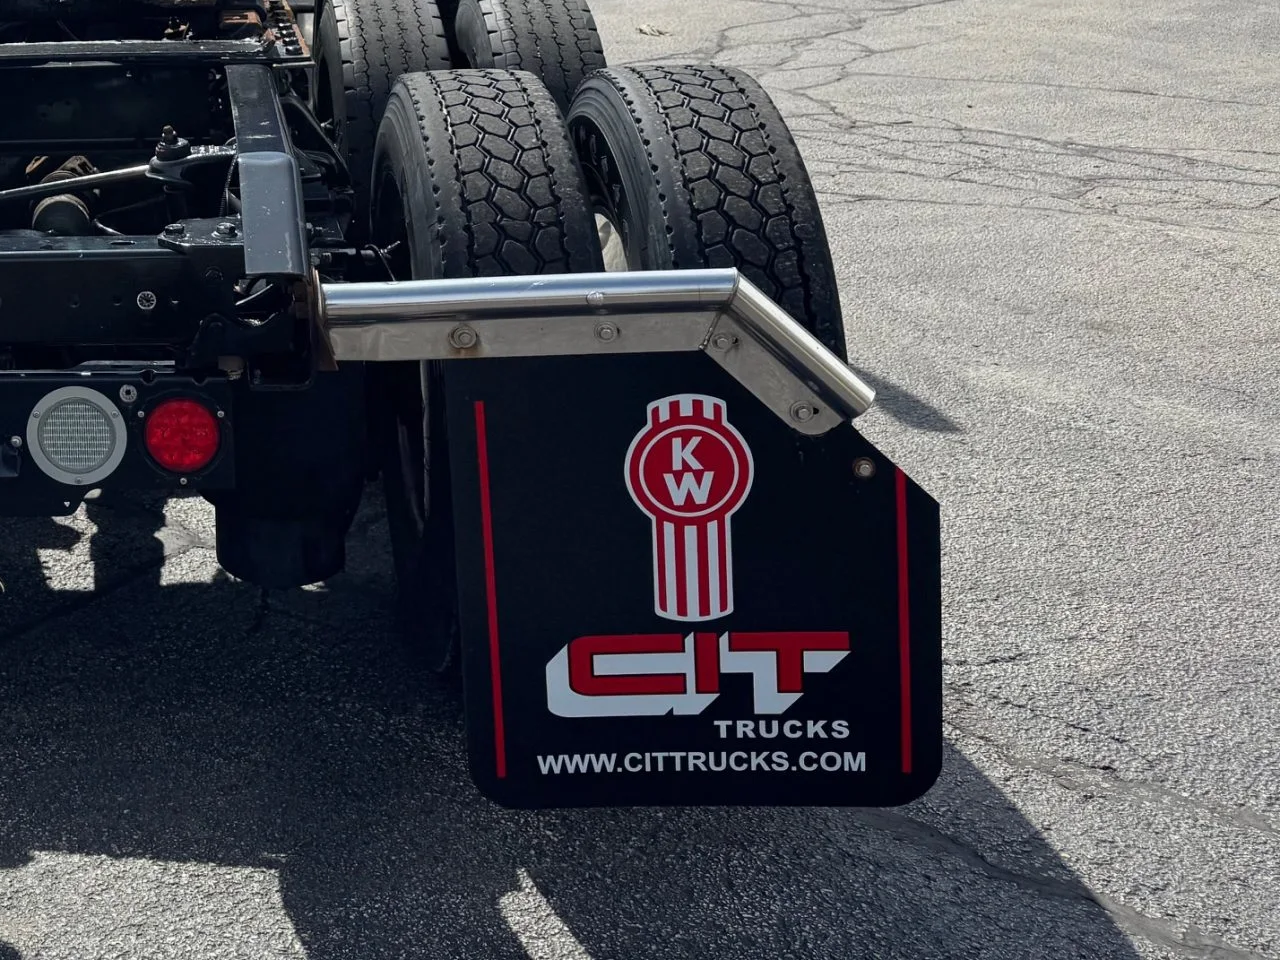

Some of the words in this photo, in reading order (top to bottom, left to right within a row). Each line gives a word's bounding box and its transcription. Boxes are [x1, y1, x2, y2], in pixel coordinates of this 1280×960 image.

[546, 631, 852, 718] CIT
[714, 719, 850, 739] TRUCKS
[536, 751, 867, 775] WWW.CITTRUCKS.COM
